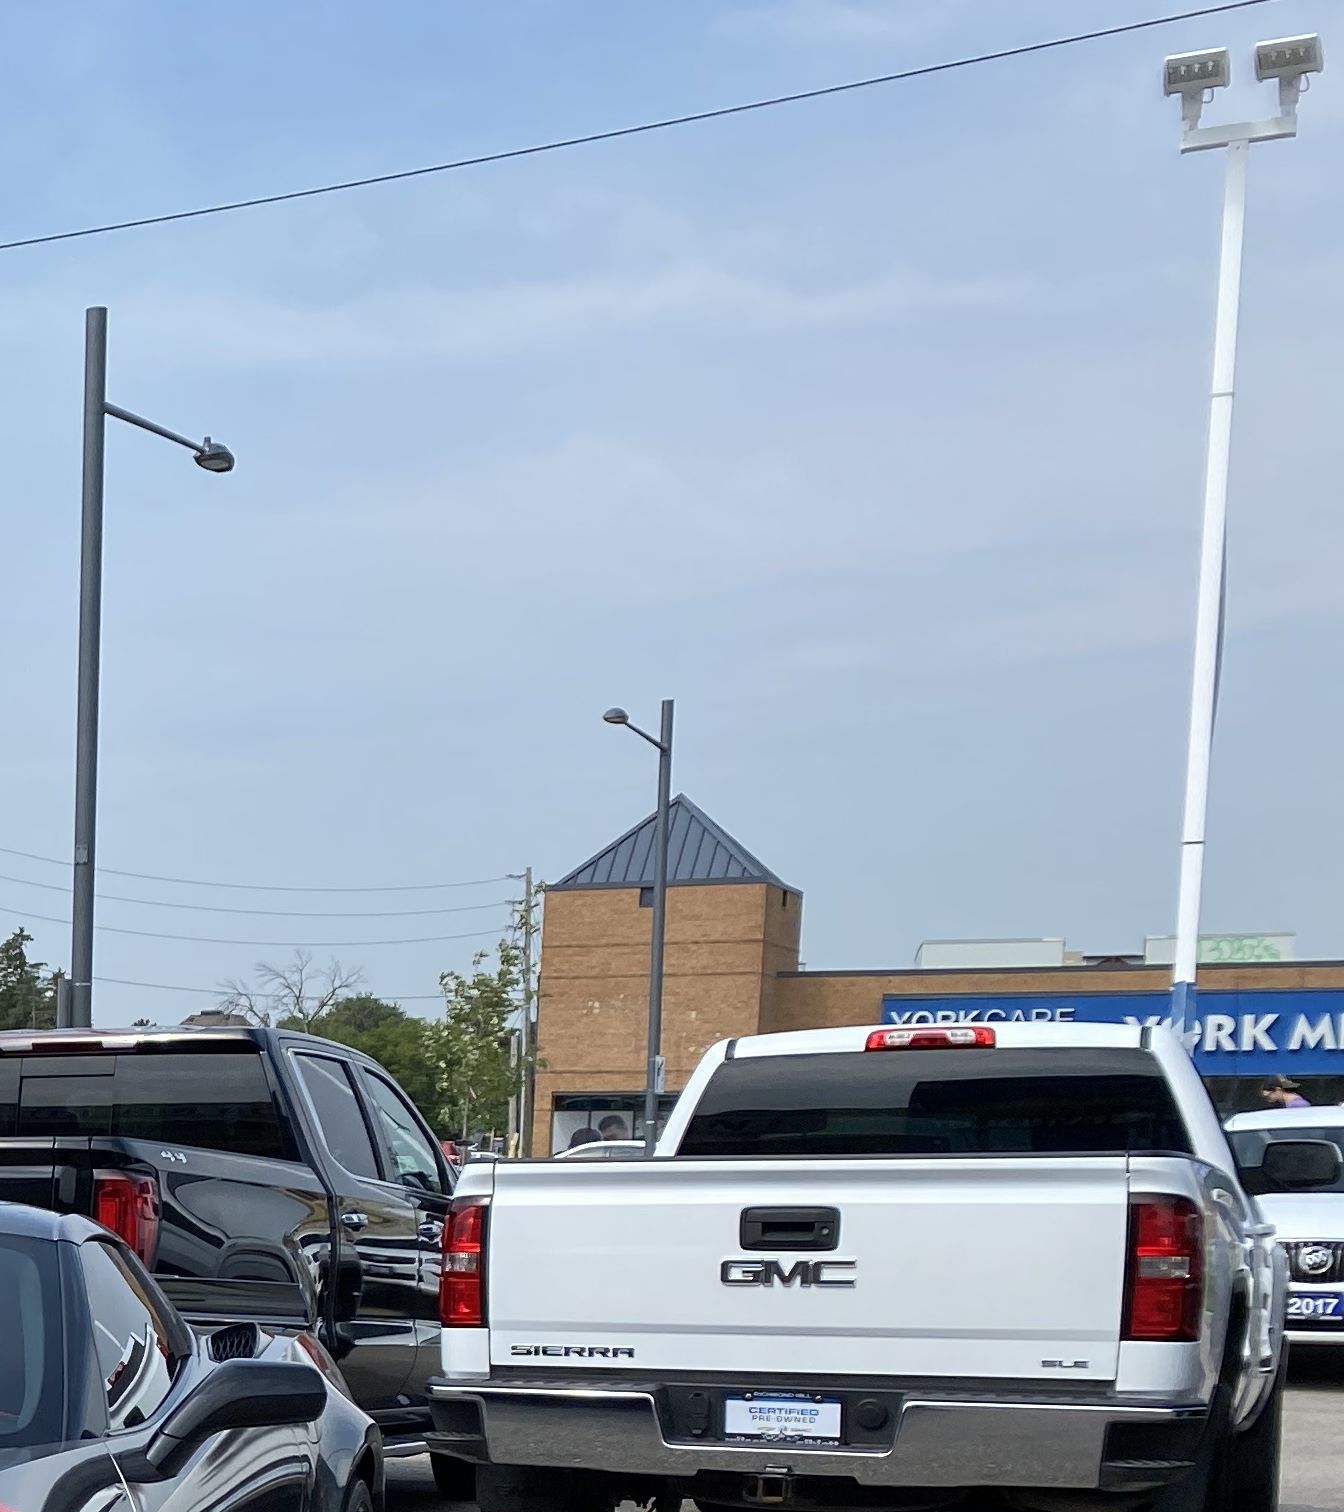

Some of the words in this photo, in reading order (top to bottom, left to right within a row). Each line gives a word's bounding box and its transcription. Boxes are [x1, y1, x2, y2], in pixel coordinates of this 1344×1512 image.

[720, 1258, 857, 1288] GMC
[1287, 1297, 1339, 1314] 2017
[510, 1344, 635, 1359] SIERRA
[748, 1406, 820, 1416] CERTIFIED
